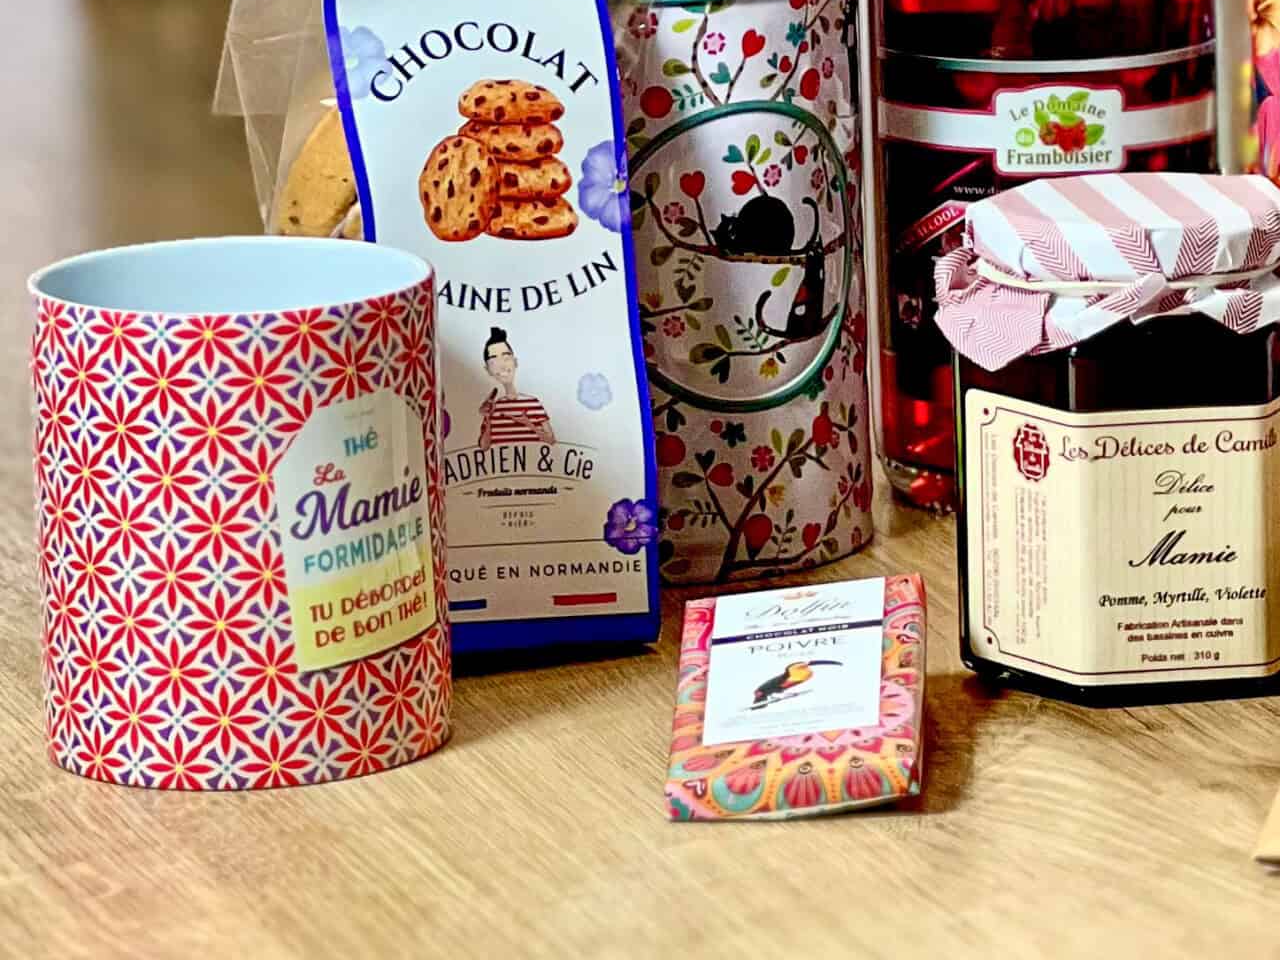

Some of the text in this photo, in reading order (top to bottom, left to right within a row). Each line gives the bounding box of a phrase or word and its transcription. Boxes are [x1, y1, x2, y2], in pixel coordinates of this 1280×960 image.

[369, 21, 599, 104] CHOCOLAT
[1009, 99, 1107, 122] Le Domaine
[1007, 147, 1113, 166] Framboisier
[521, 280, 562, 312] DE
[566, 250, 618, 297] LIN
[1058, 435, 1089, 462] Les
[1089, 435, 1175, 461] Délices
[1182, 434, 1208, 454] de
[313, 462, 346, 487] La
[443, 445, 594, 485] ADRIEN & Cie
[1153, 470, 1215, 495] Délice
[290, 466, 423, 540] Mamie
[1163, 503, 1203, 522] pour
[304, 517, 424, 575] FORMIDABLE
[1128, 529, 1238, 568] Mamie
[497, 566, 520, 579] EN
[530, 559, 641, 577] NORMANDIE
[1098, 594, 1149, 608] Pomme,
[1215, 586, 1267, 601] Violette
[310, 602, 333, 623] TU
[1220, 618, 1244, 626] dans
[748, 636, 846, 655] POIVRE
[1147, 632, 1189, 641] bassines
[1191, 631, 1203, 639] en
[1205, 629, 1234, 639] cuivre
[1193, 651, 1212, 661] 310
[1213, 651, 1220, 661] g
